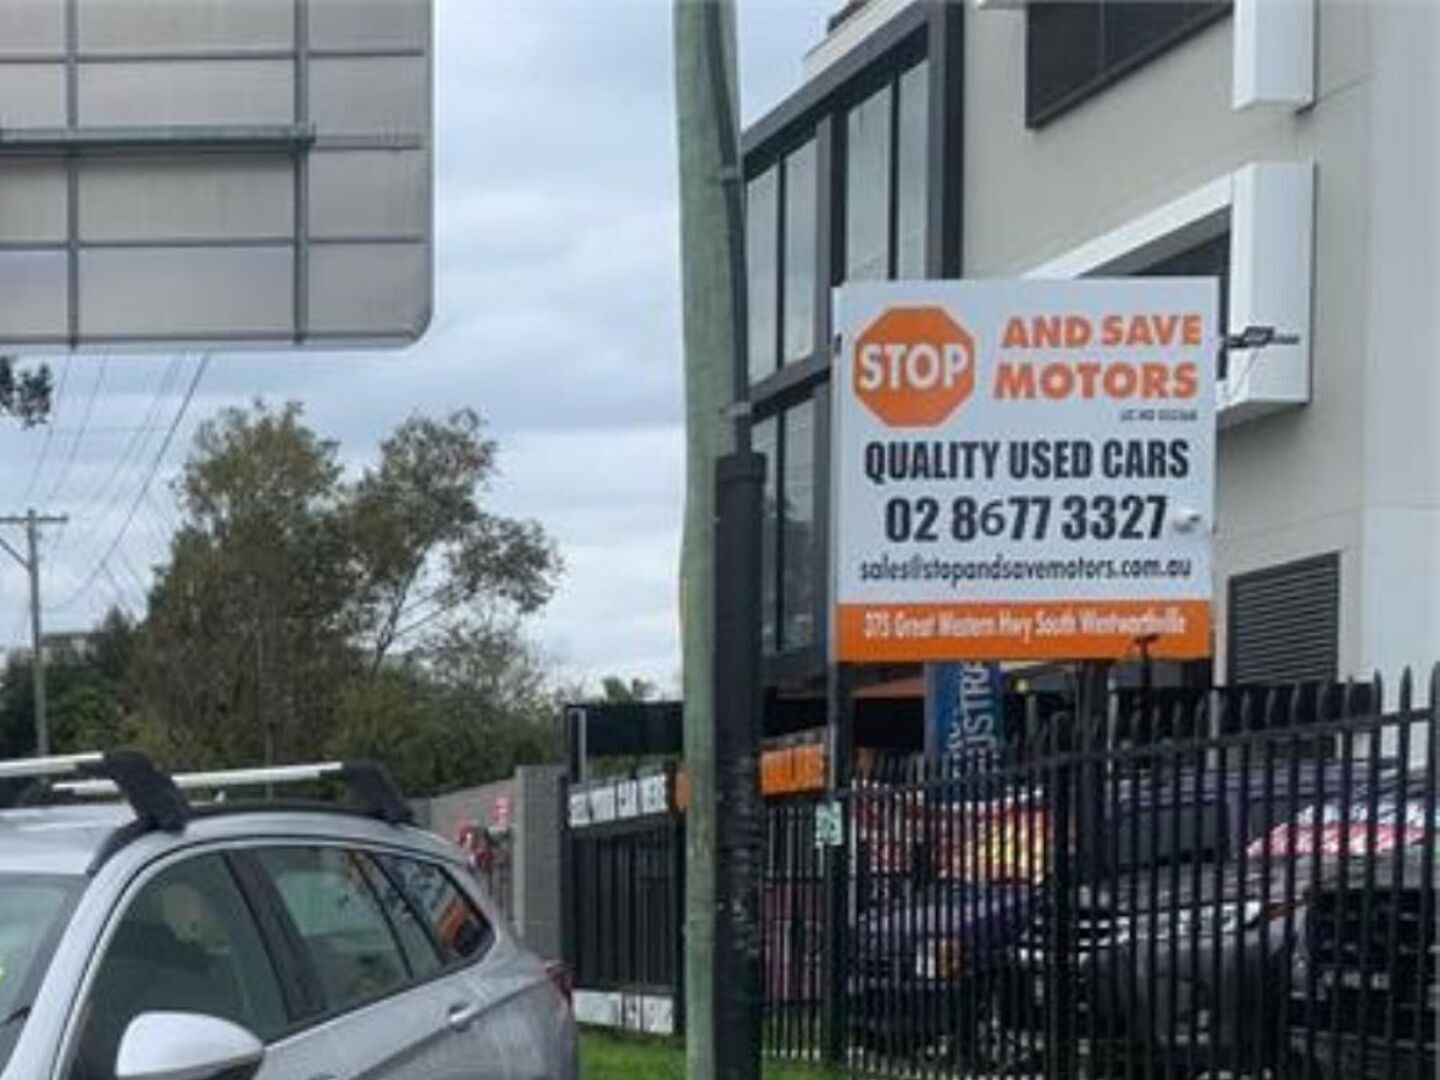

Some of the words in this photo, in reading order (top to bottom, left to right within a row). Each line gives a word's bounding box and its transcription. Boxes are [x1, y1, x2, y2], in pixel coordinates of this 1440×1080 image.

[1001, 315, 1091, 349] AND
[1100, 314, 1202, 347] SAVE
[858, 343, 970, 390] STOP
[993, 362, 1199, 400] MOTORS
[864, 440, 1001, 484] QUALITY
[1008, 439, 1093, 480] USED
[1101, 438, 1190, 479] CARS
[884, 496, 940, 543] 02
[951, 495, 1052, 541] 8677
[1061, 493, 1168, 541] 3327
